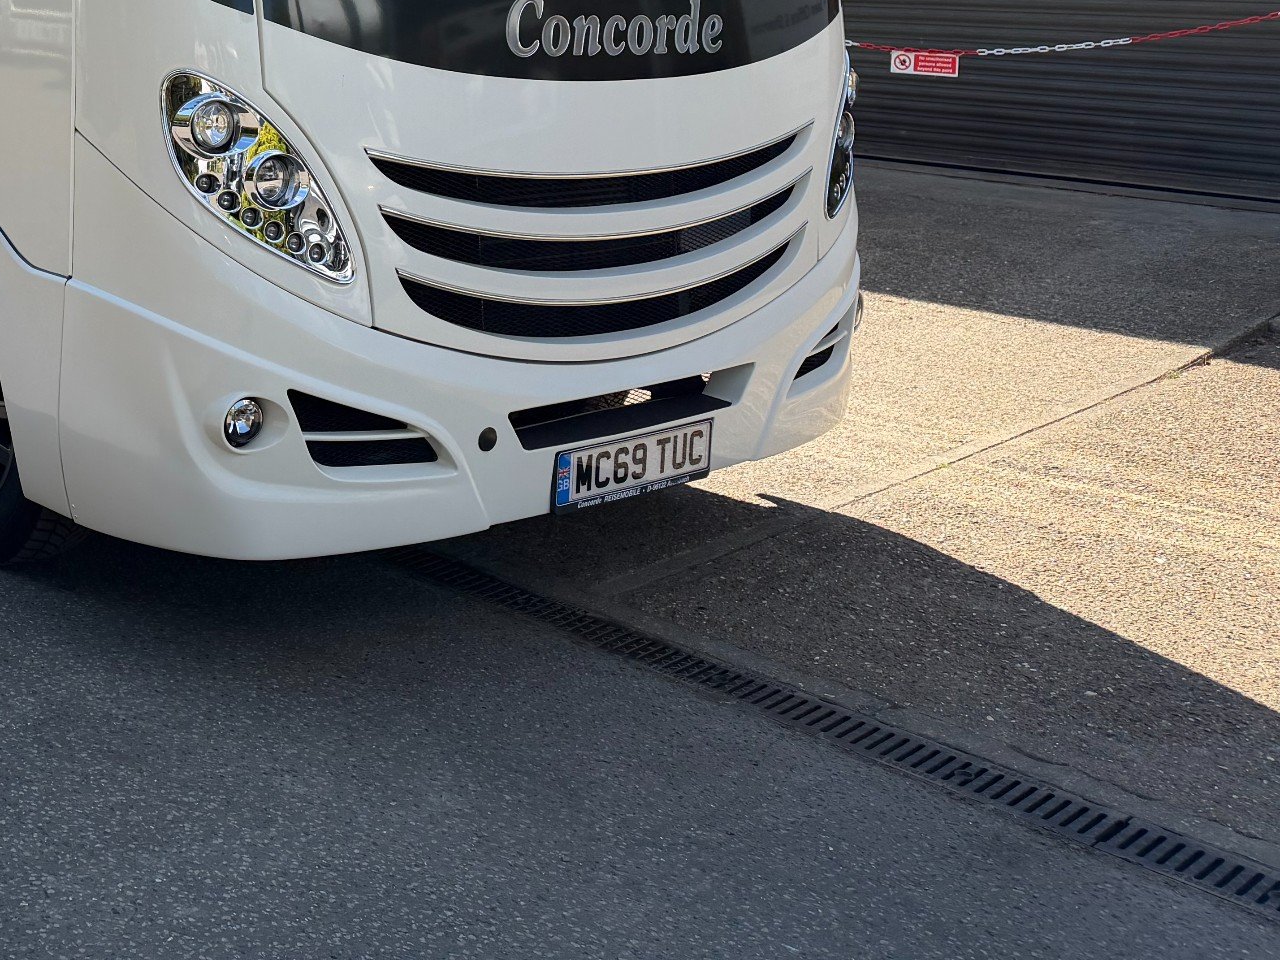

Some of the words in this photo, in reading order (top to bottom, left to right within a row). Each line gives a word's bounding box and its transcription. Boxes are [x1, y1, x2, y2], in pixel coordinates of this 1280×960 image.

[575, 442, 648, 494] MC69
[656, 429, 704, 474] TUC
[557, 478, 570, 492] GB
